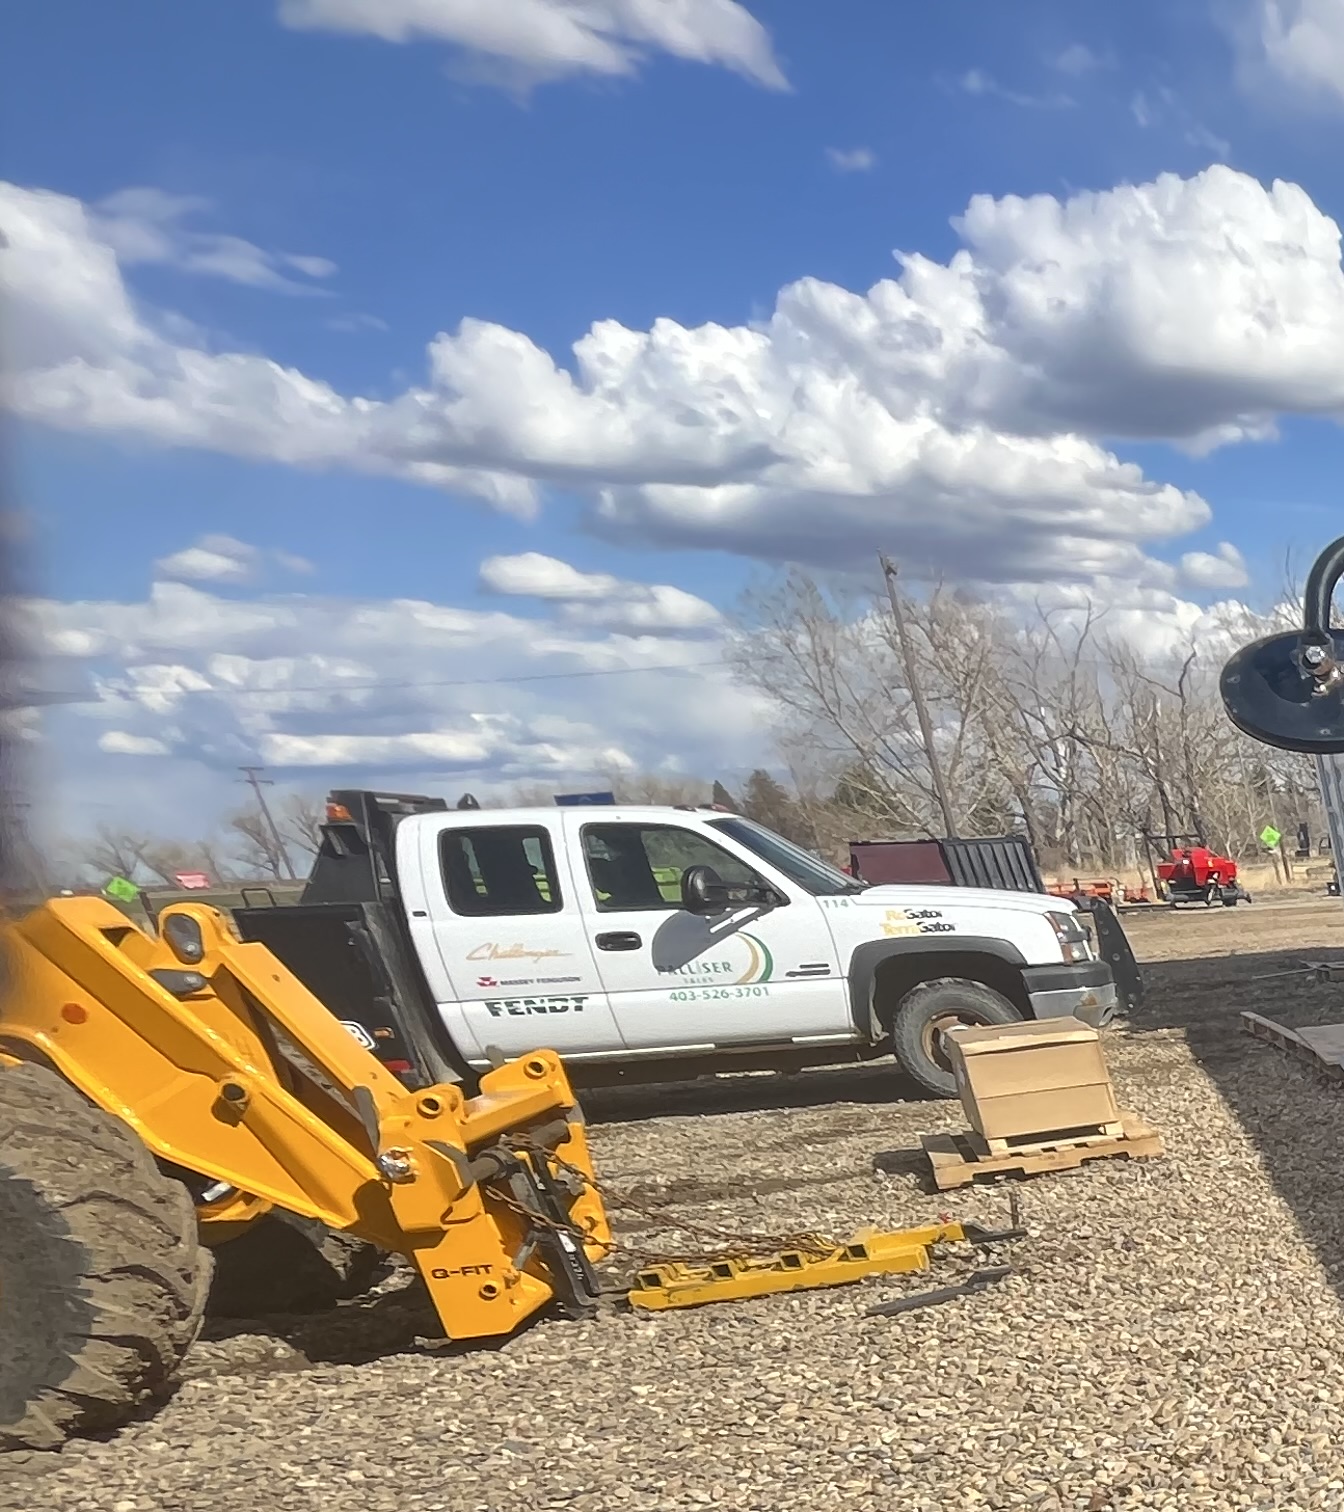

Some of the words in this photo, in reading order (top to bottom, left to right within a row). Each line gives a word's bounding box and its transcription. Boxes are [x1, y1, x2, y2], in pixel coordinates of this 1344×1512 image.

[824, 899, 849, 909] 114
[536, 976, 581, 984] FERGUSON
[669, 986, 769, 1002] 403-526-3701
[485, 996, 589, 1017] FENDT
